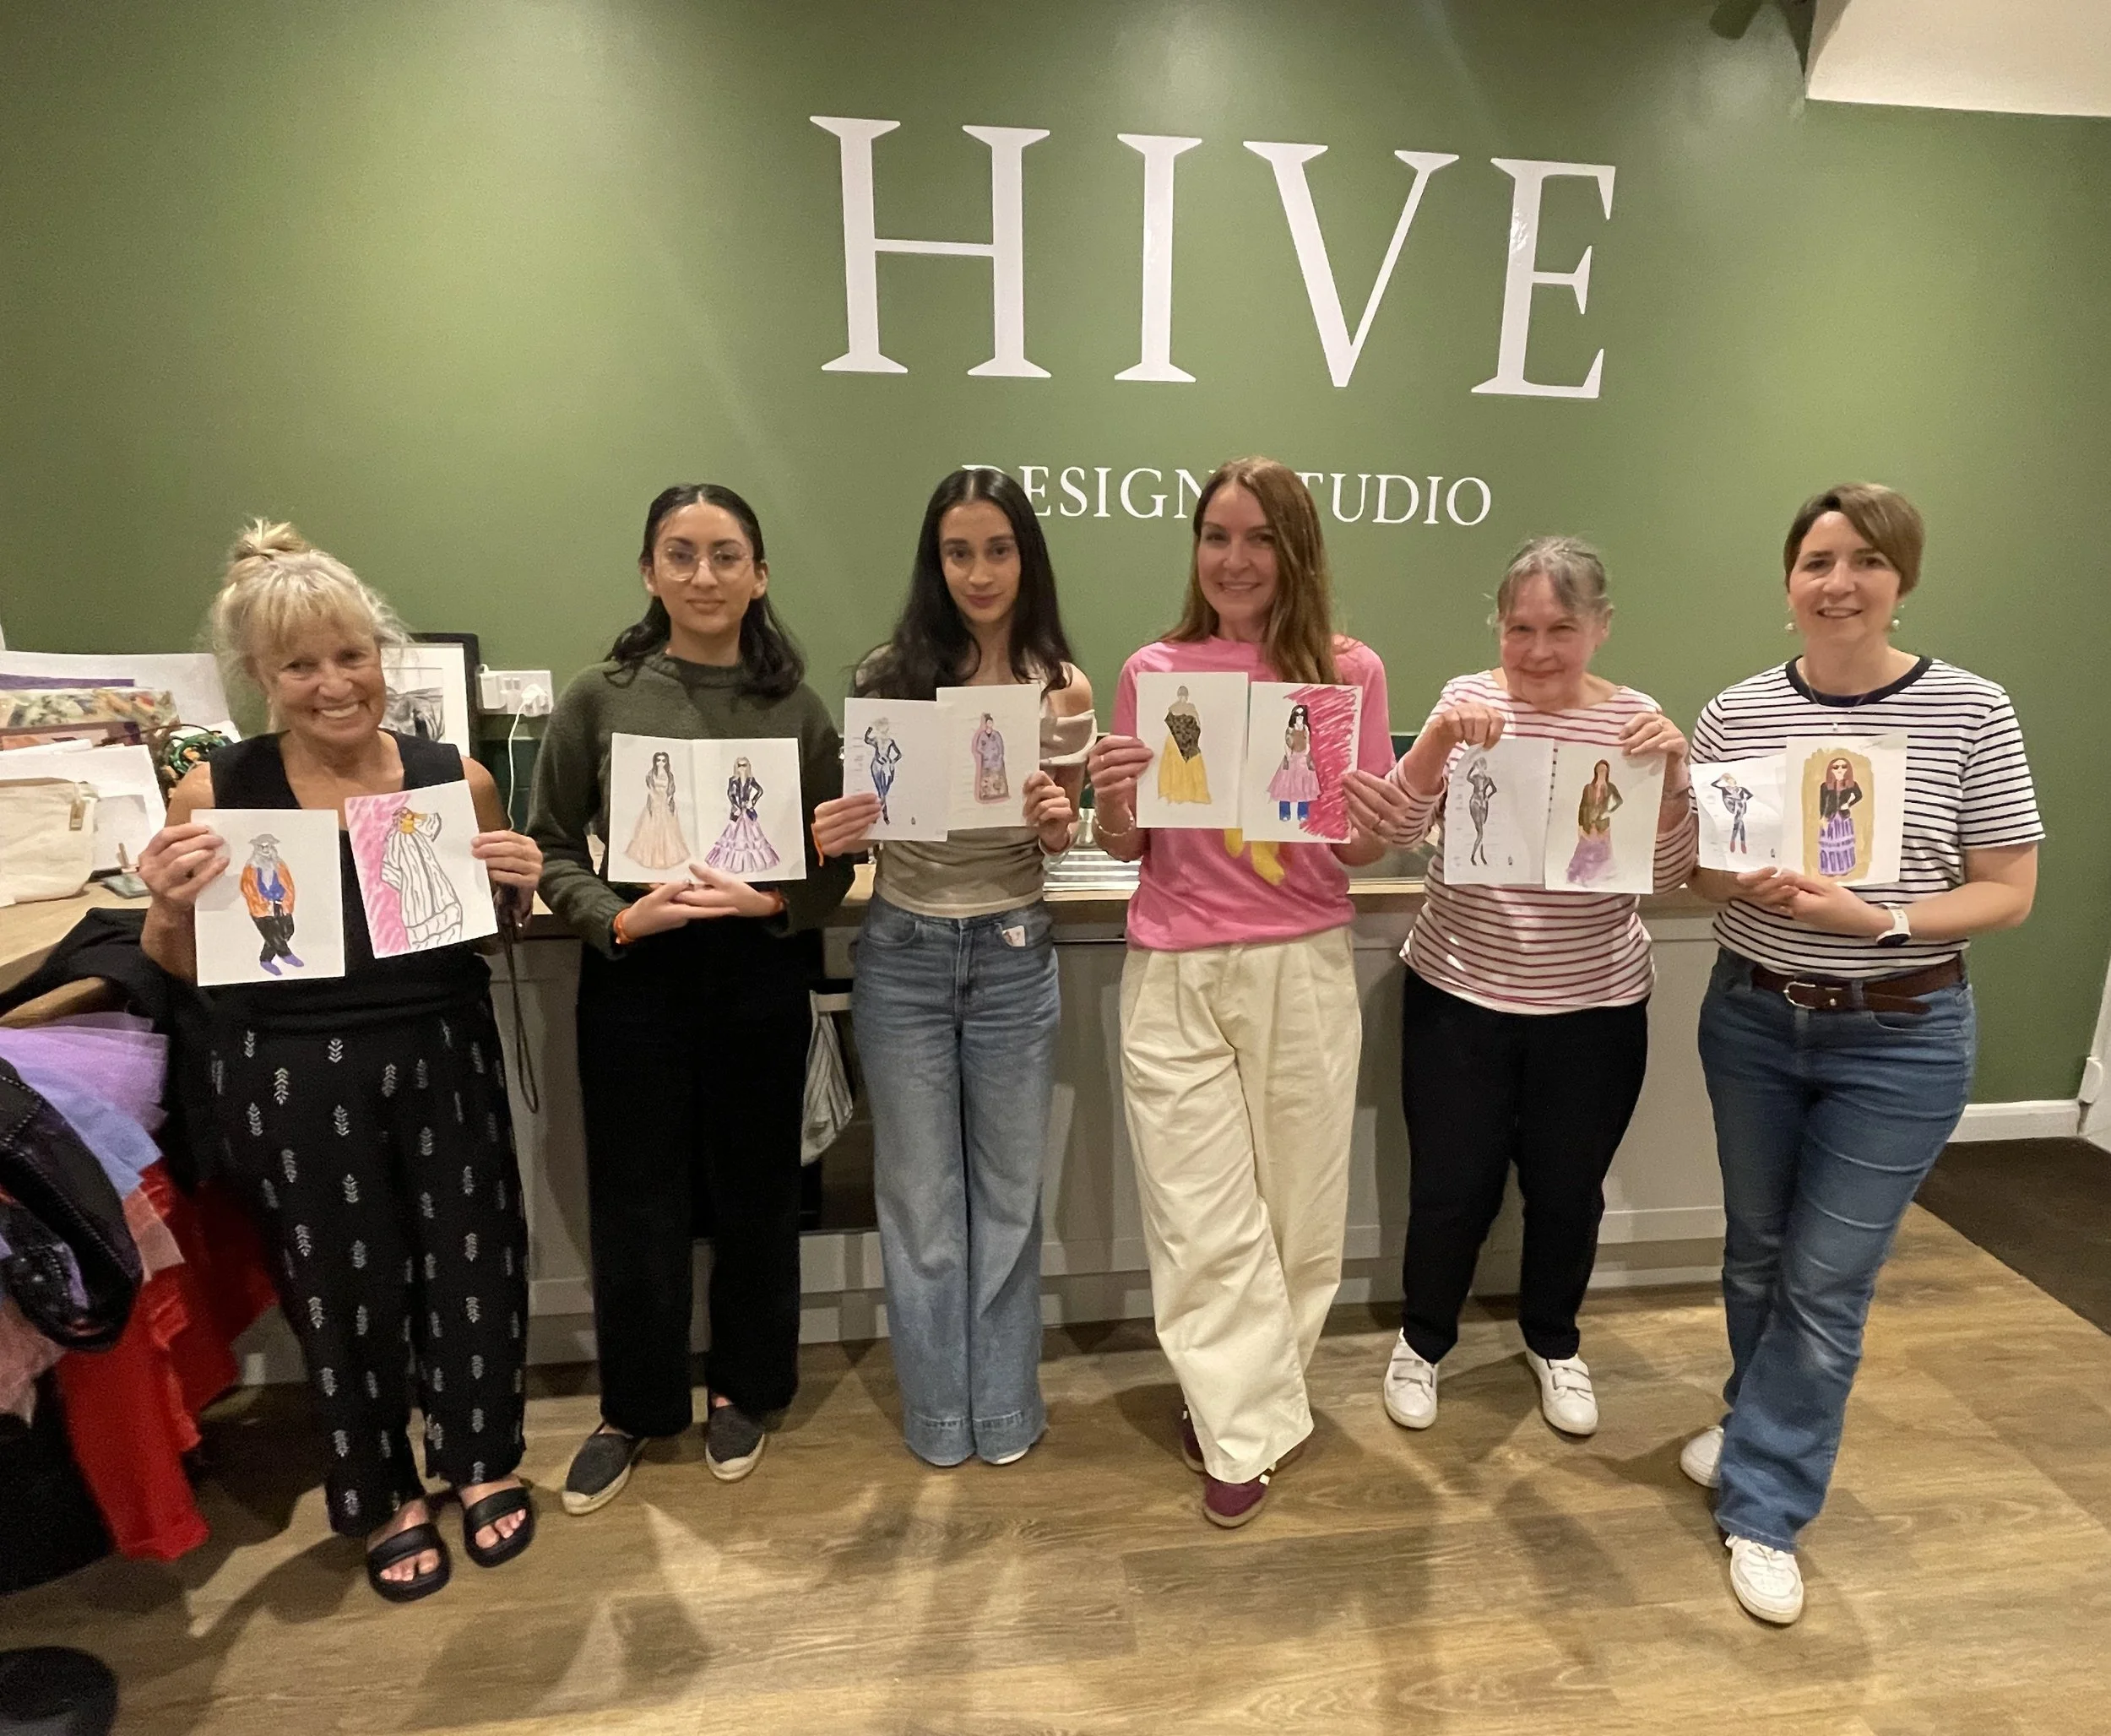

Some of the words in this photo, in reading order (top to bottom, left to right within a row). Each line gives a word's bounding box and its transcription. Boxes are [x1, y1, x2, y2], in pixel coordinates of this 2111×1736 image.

[809, 116, 1617, 399] HIVE
[961, 464, 1216, 519] ESIGN
[1294, 471, 1492, 526] TUDIO
